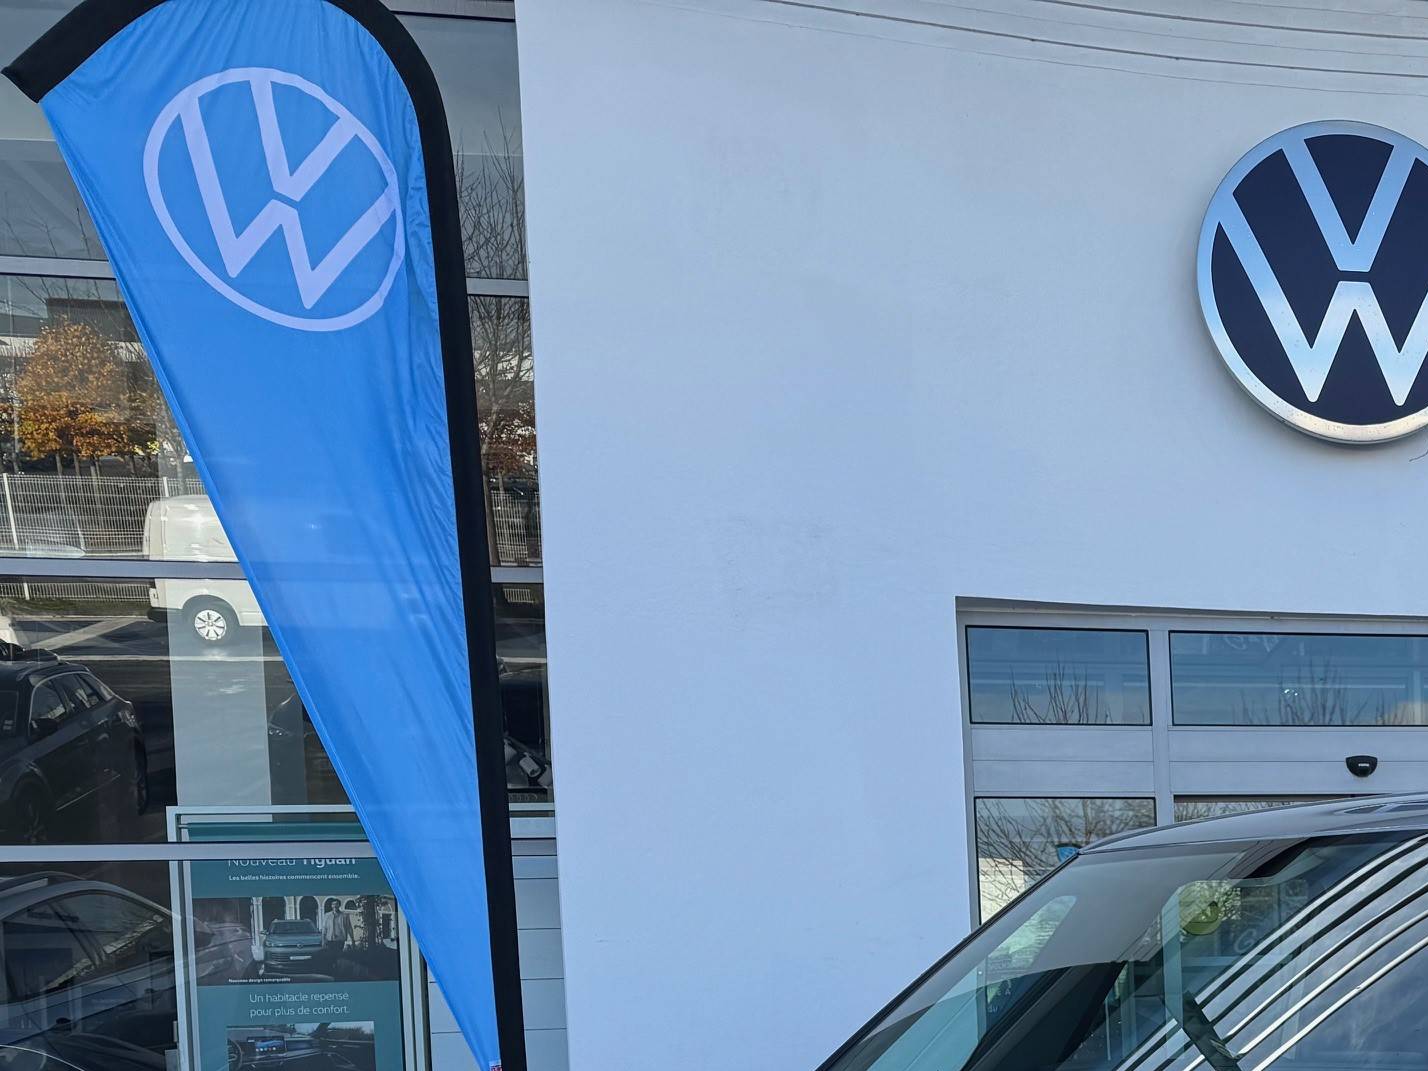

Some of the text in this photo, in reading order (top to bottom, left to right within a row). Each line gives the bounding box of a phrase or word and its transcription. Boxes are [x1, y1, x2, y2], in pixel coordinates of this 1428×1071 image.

[249, 993, 264, 1003] Un
[265, 992, 308, 1002] habitacle
[250, 1004, 350, 1018] pour plus de confort.
